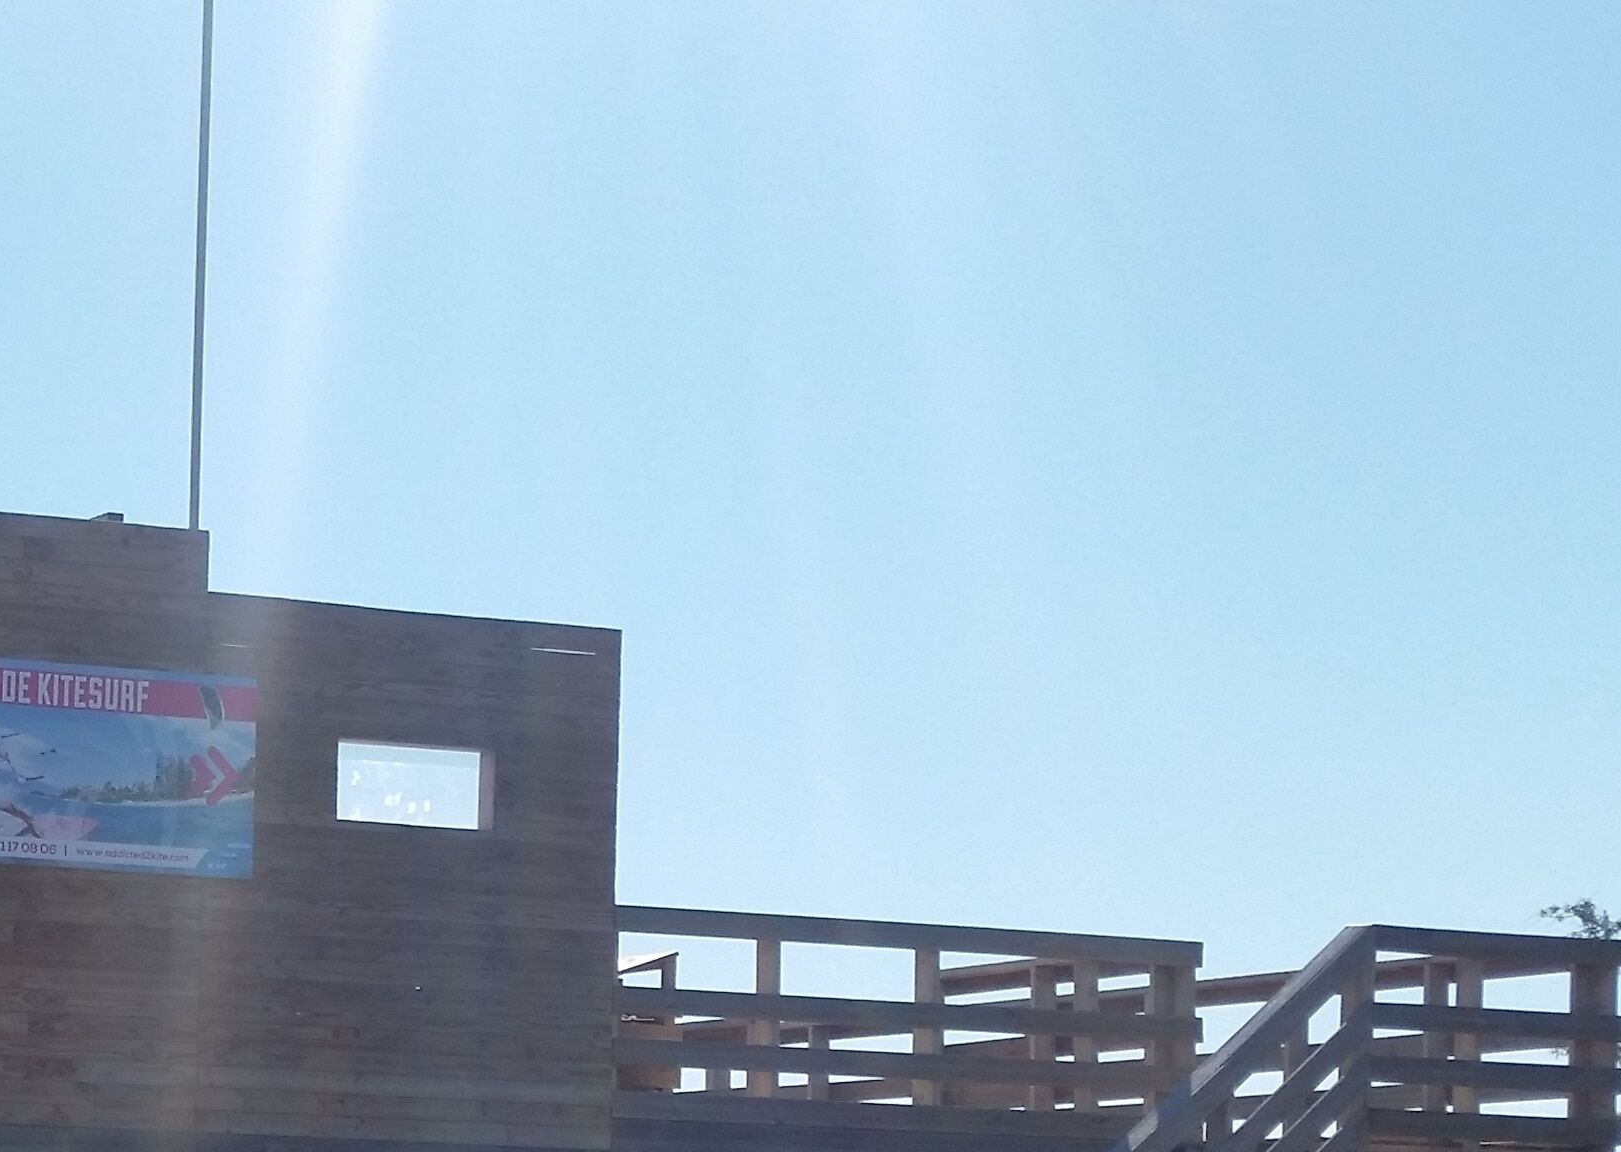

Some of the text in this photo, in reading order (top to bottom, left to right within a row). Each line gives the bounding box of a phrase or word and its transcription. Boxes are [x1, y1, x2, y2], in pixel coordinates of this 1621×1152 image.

[1, 669, 31, 704] DE
[37, 672, 150, 713] KITESURF
[40, 843, 57, 855] 06
